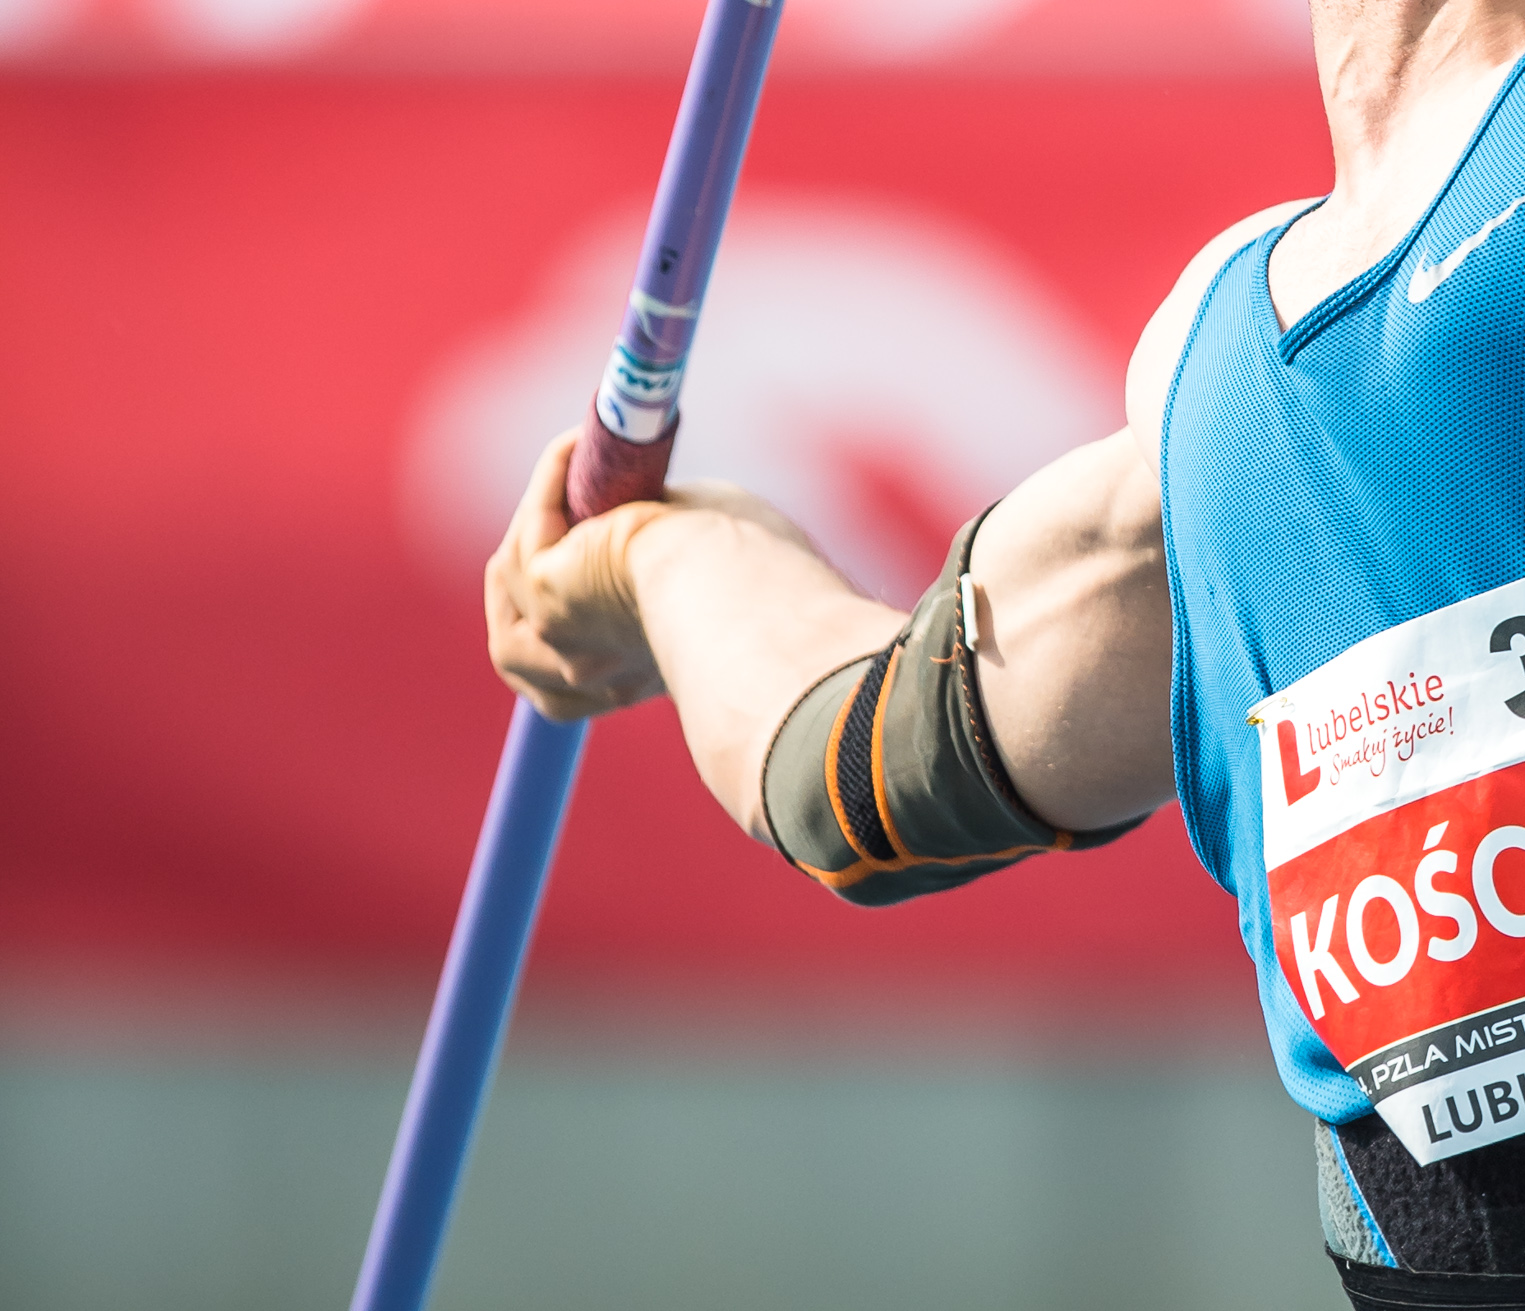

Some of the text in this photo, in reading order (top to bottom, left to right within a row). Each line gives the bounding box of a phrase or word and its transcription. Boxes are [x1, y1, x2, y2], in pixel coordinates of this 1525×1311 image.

[1306, 671, 1445, 756] lubelskie
[1392, 706, 1455, 762] życie!
[1371, 1043, 1449, 1090] PZLA
